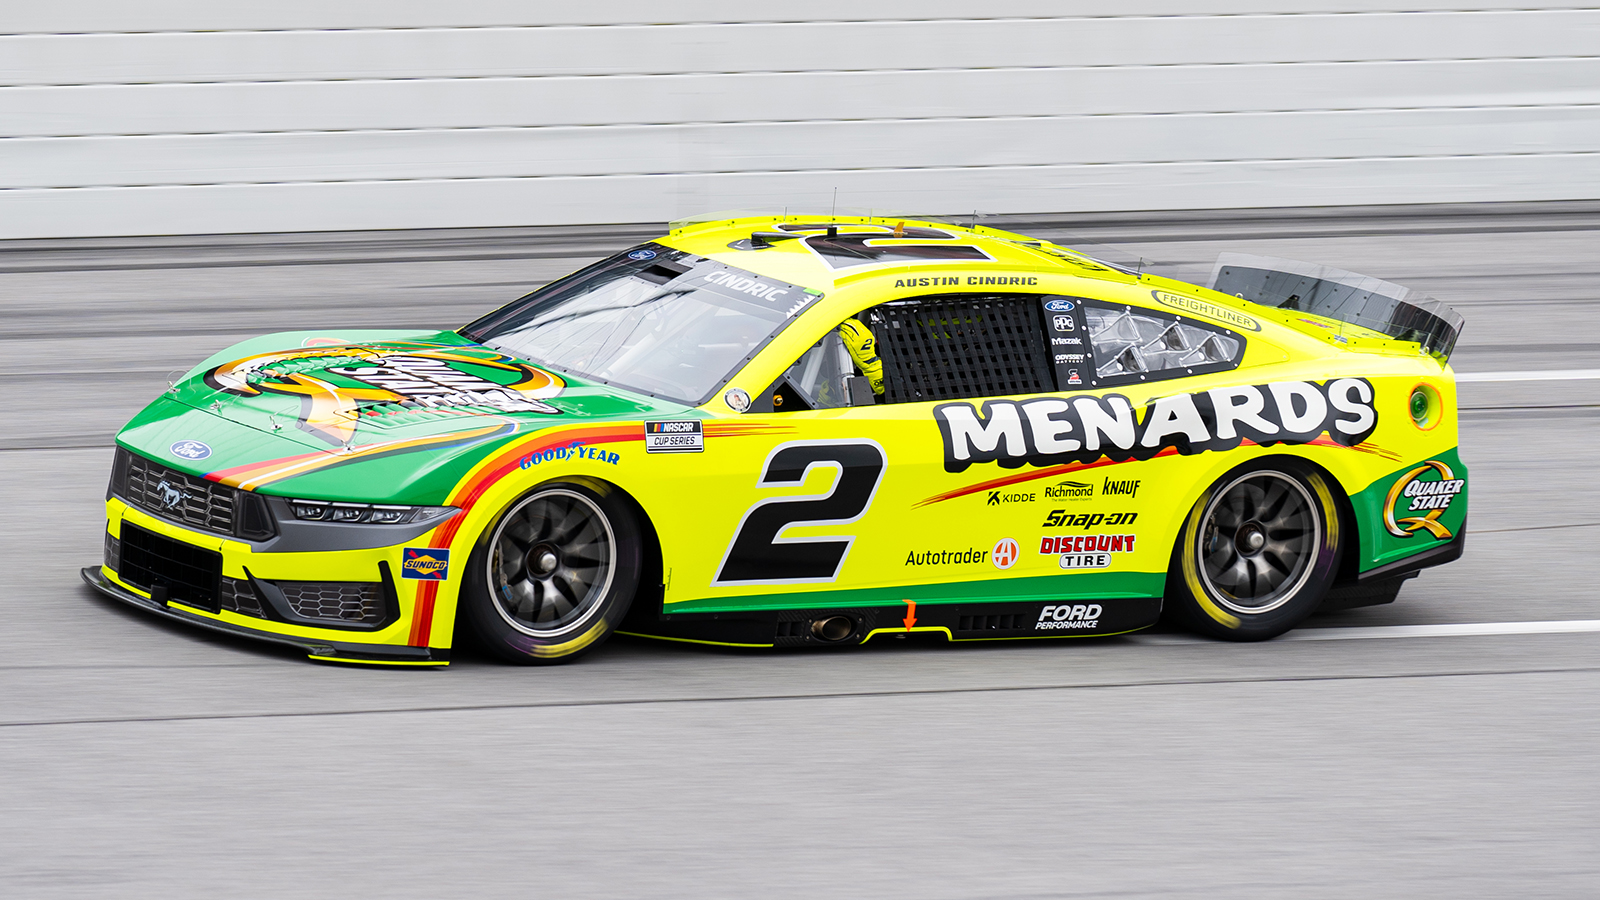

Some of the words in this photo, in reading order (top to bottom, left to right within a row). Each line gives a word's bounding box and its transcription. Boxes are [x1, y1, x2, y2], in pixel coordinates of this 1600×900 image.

[703, 270, 789, 302] CINDRIC
[894, 276, 960, 288] AUSTIN
[967, 276, 1038, 286] CINDRIC
[1049, 301, 1071, 310] Ford
[1162, 293, 1252, 328] FREIGHTLINER
[1055, 317, 1074, 329] PPG
[860, 338, 873, 350] 2
[1051, 337, 1082, 345] Mazak
[937, 376, 1377, 463] MENARDS
[663, 422, 694, 433] NASCAR
[654, 436, 670, 446] CUP
[670, 436, 696, 446] SERIES
[173, 441, 206, 458] Ford
[1044, 484, 1094, 498] Richmond
[1102, 476, 1141, 498] KNAUF
[1404, 479, 1465, 497] QUAKER
[1002, 493, 1036, 503] KIDDE
[1408, 494, 1454, 511] STATE
[709, 437, 888, 587] 2
[1042, 509, 1138, 530] Snap-on
[1039, 534, 1136, 554] DISCOUNT
[905, 547, 989, 566] Autotrader
[1064, 555, 1106, 567] TIRE
[405, 560, 446, 570] SUNOCO
[1038, 604, 1102, 622] FORD
[1035, 620, 1099, 630] PERFORMANCE
